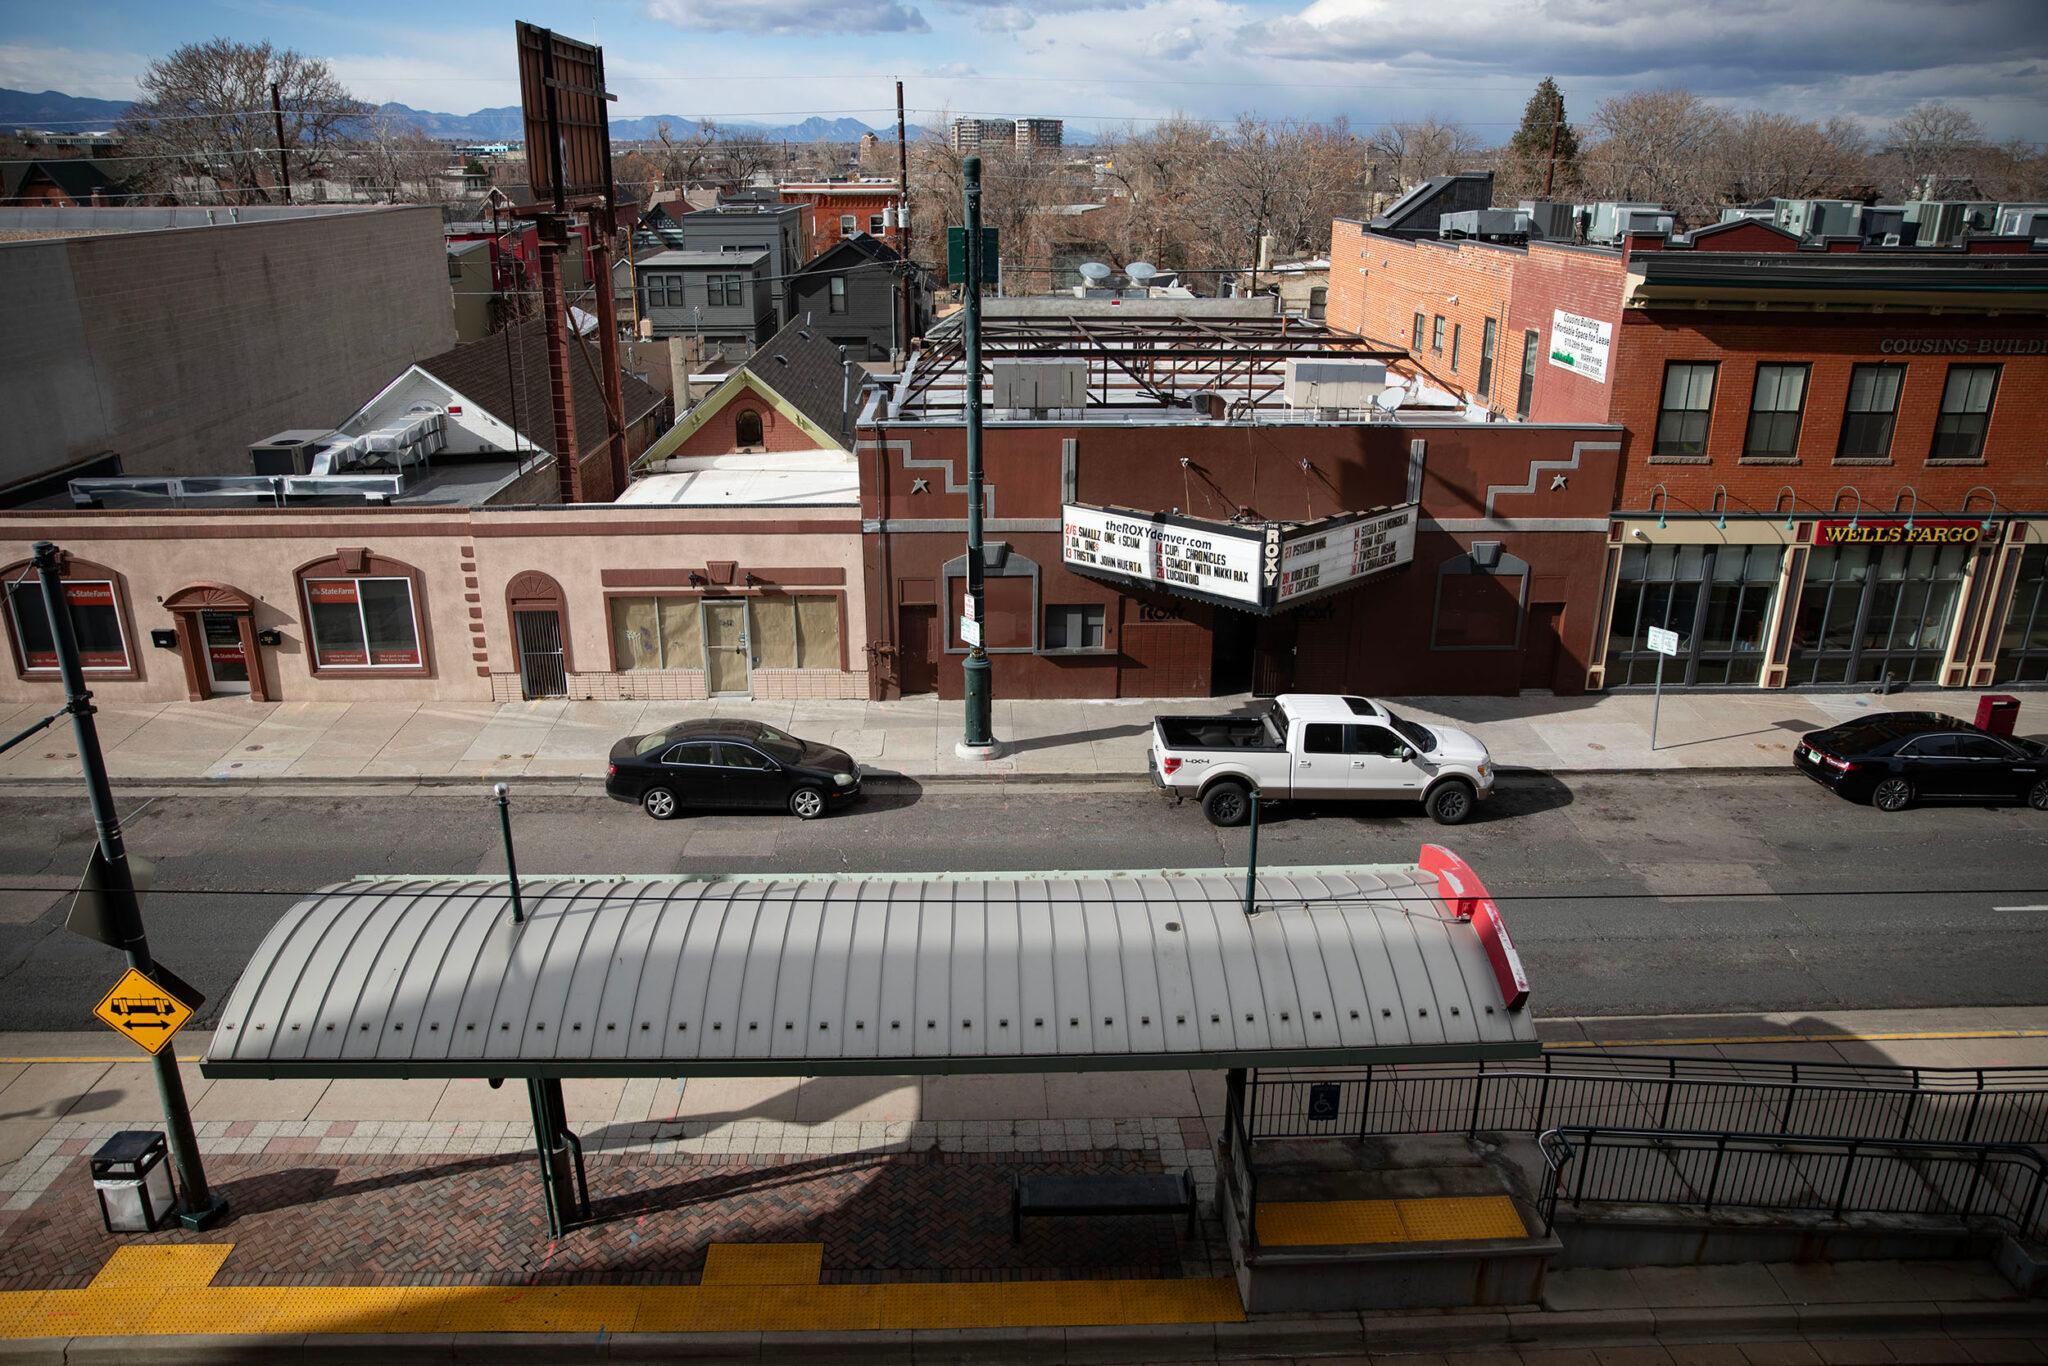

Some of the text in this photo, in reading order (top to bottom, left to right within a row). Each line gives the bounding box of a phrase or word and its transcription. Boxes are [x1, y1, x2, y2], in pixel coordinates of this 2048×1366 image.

[1575, 328, 1588, 341] Space
[1596, 334, 1609, 346] Lease
[1880, 338, 1969, 353] COUSINS
[1065, 523, 1077, 536] 2/6
[1078, 526, 1101, 542] SMALLZ
[1104, 531, 1116, 545] ONE
[1122, 535, 1141, 549] SCUM
[1071, 537, 1080, 548] DA
[1105, 521, 1212, 550] theROXYdenver.com
[1826, 527, 1979, 543] WELLS FARGO
[1155, 542, 1163, 554] 14
[1284, 545, 1293, 559] 27
[1065, 547, 1072, 559] 13
[1100, 555, 1116, 568] JOHN
[1116, 558, 1143, 574] HUERTA
[1263, 529, 1280, 586] ROXY
[1155, 555, 1249, 583] 15 COMEDY WITH NIKKI RAX
